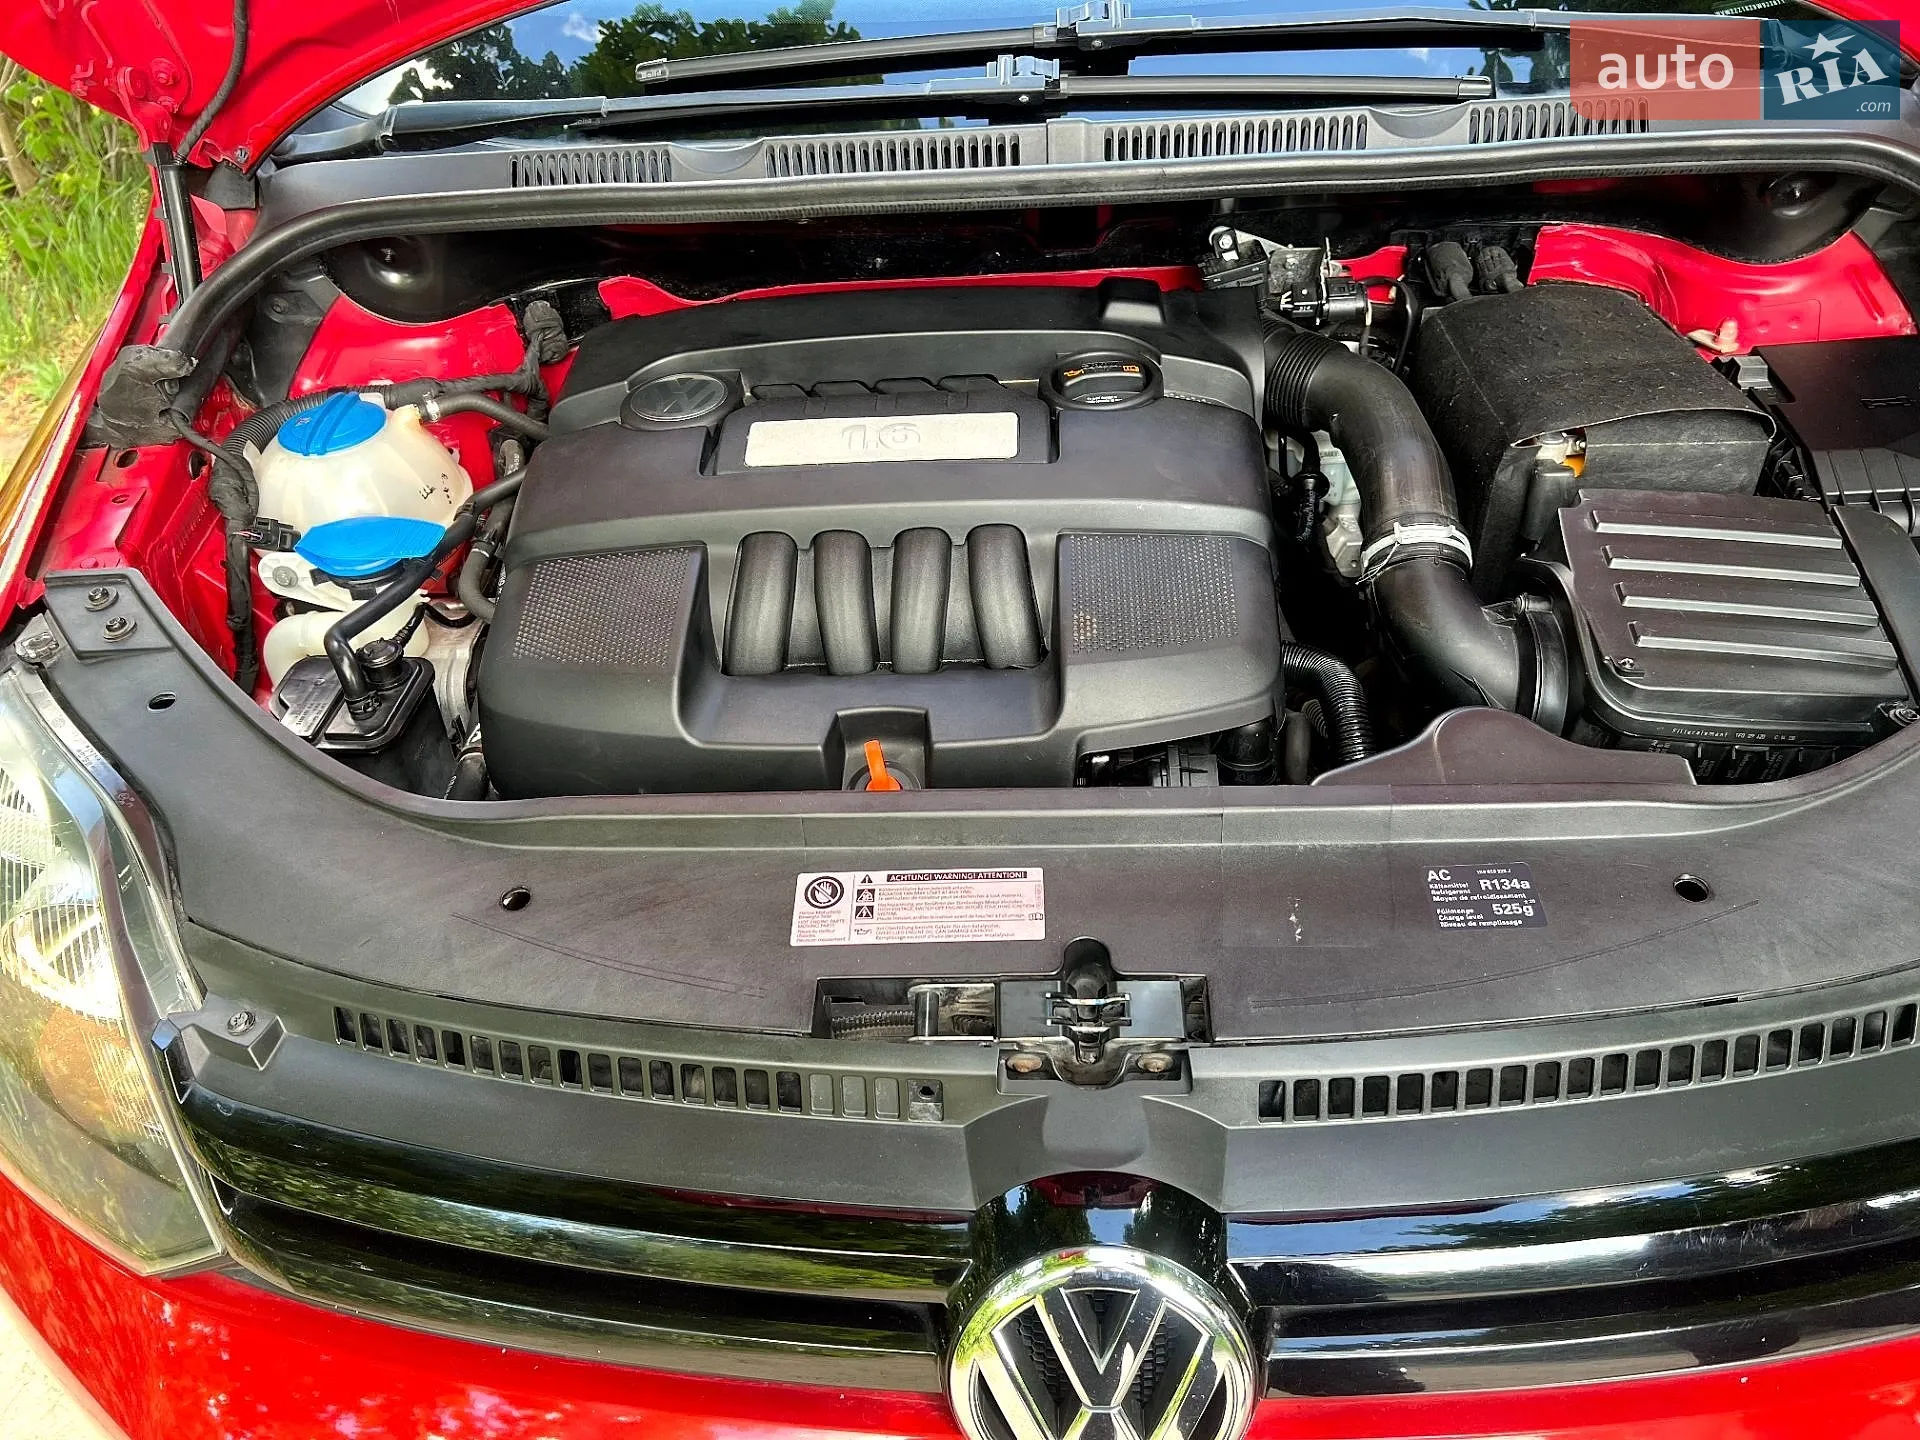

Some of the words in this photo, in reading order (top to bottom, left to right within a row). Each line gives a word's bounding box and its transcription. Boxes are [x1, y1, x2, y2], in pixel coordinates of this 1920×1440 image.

[889, 873, 932, 881] ACHTUNG!
[933, 872, 976, 880] WARNING!
[977, 871, 1025, 880] ATTENTION!
[1427, 869, 1452, 882] AC
[1479, 878, 1531, 891] R134a
[1432, 895, 1457, 903] Moyen
[1440, 920, 1466, 928] Niveau
[1478, 919, 1522, 927] remplissage
